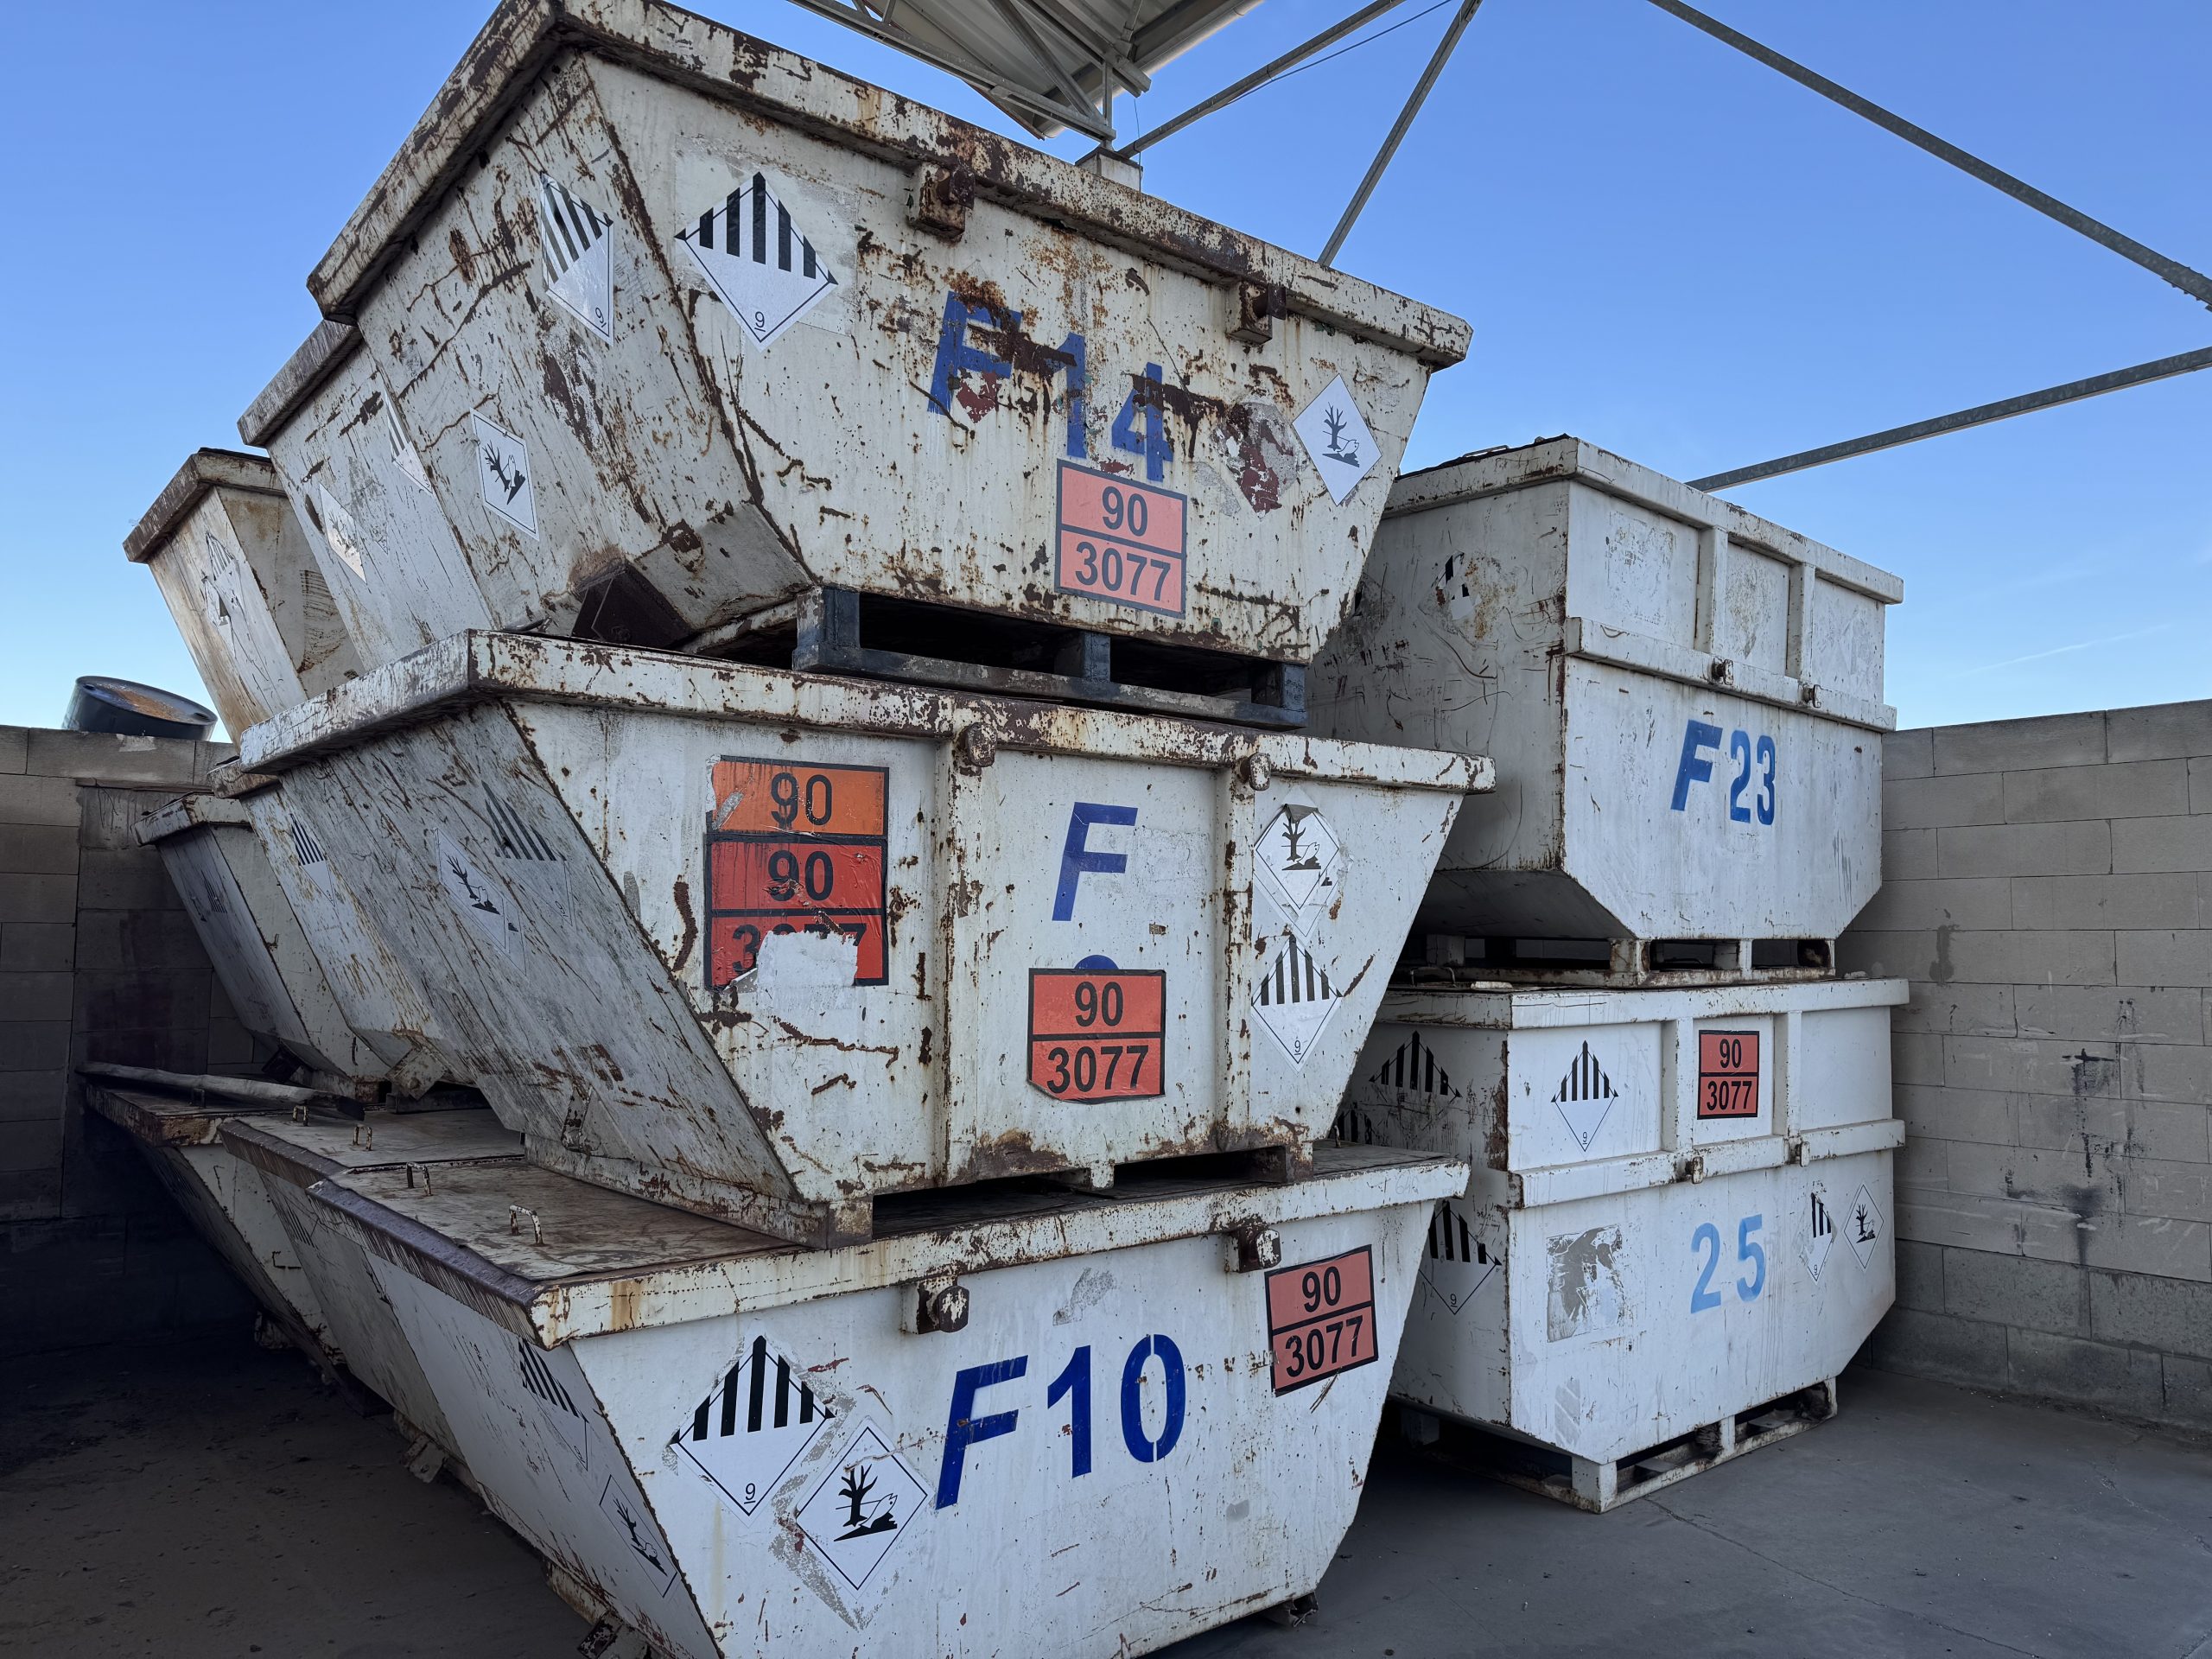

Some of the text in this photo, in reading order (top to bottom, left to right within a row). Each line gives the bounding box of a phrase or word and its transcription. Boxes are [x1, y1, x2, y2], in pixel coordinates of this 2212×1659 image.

[594, 307, 606, 325] 9
[754, 311, 765, 329] 9
[927, 290, 1173, 482] F14
[1102, 486, 1148, 537] 90
[1075, 541, 1171, 601] 3077
[770, 772, 833, 827] 90
[766, 849, 834, 901] 90
[1052, 802, 1138, 922] F
[1074, 981, 1124, 1027] 90
[1294, 1039, 1301, 1053] 9
[1719, 1038, 1742, 1069] 90
[1046, 1045, 1149, 1095] 3077
[1706, 1080, 1752, 1111] 3077
[1582, 1131, 1588, 1143] 9
[1690, 1214, 1766, 1314] 25
[1301, 1266, 1342, 1313] 90
[1450, 1294, 1458, 1306] 9
[1285, 1314, 1363, 1378] 3077
[934, 1333, 1186, 1510] F10
[574, 1445, 584, 1462] 9
[745, 1483, 756, 1502] 9
